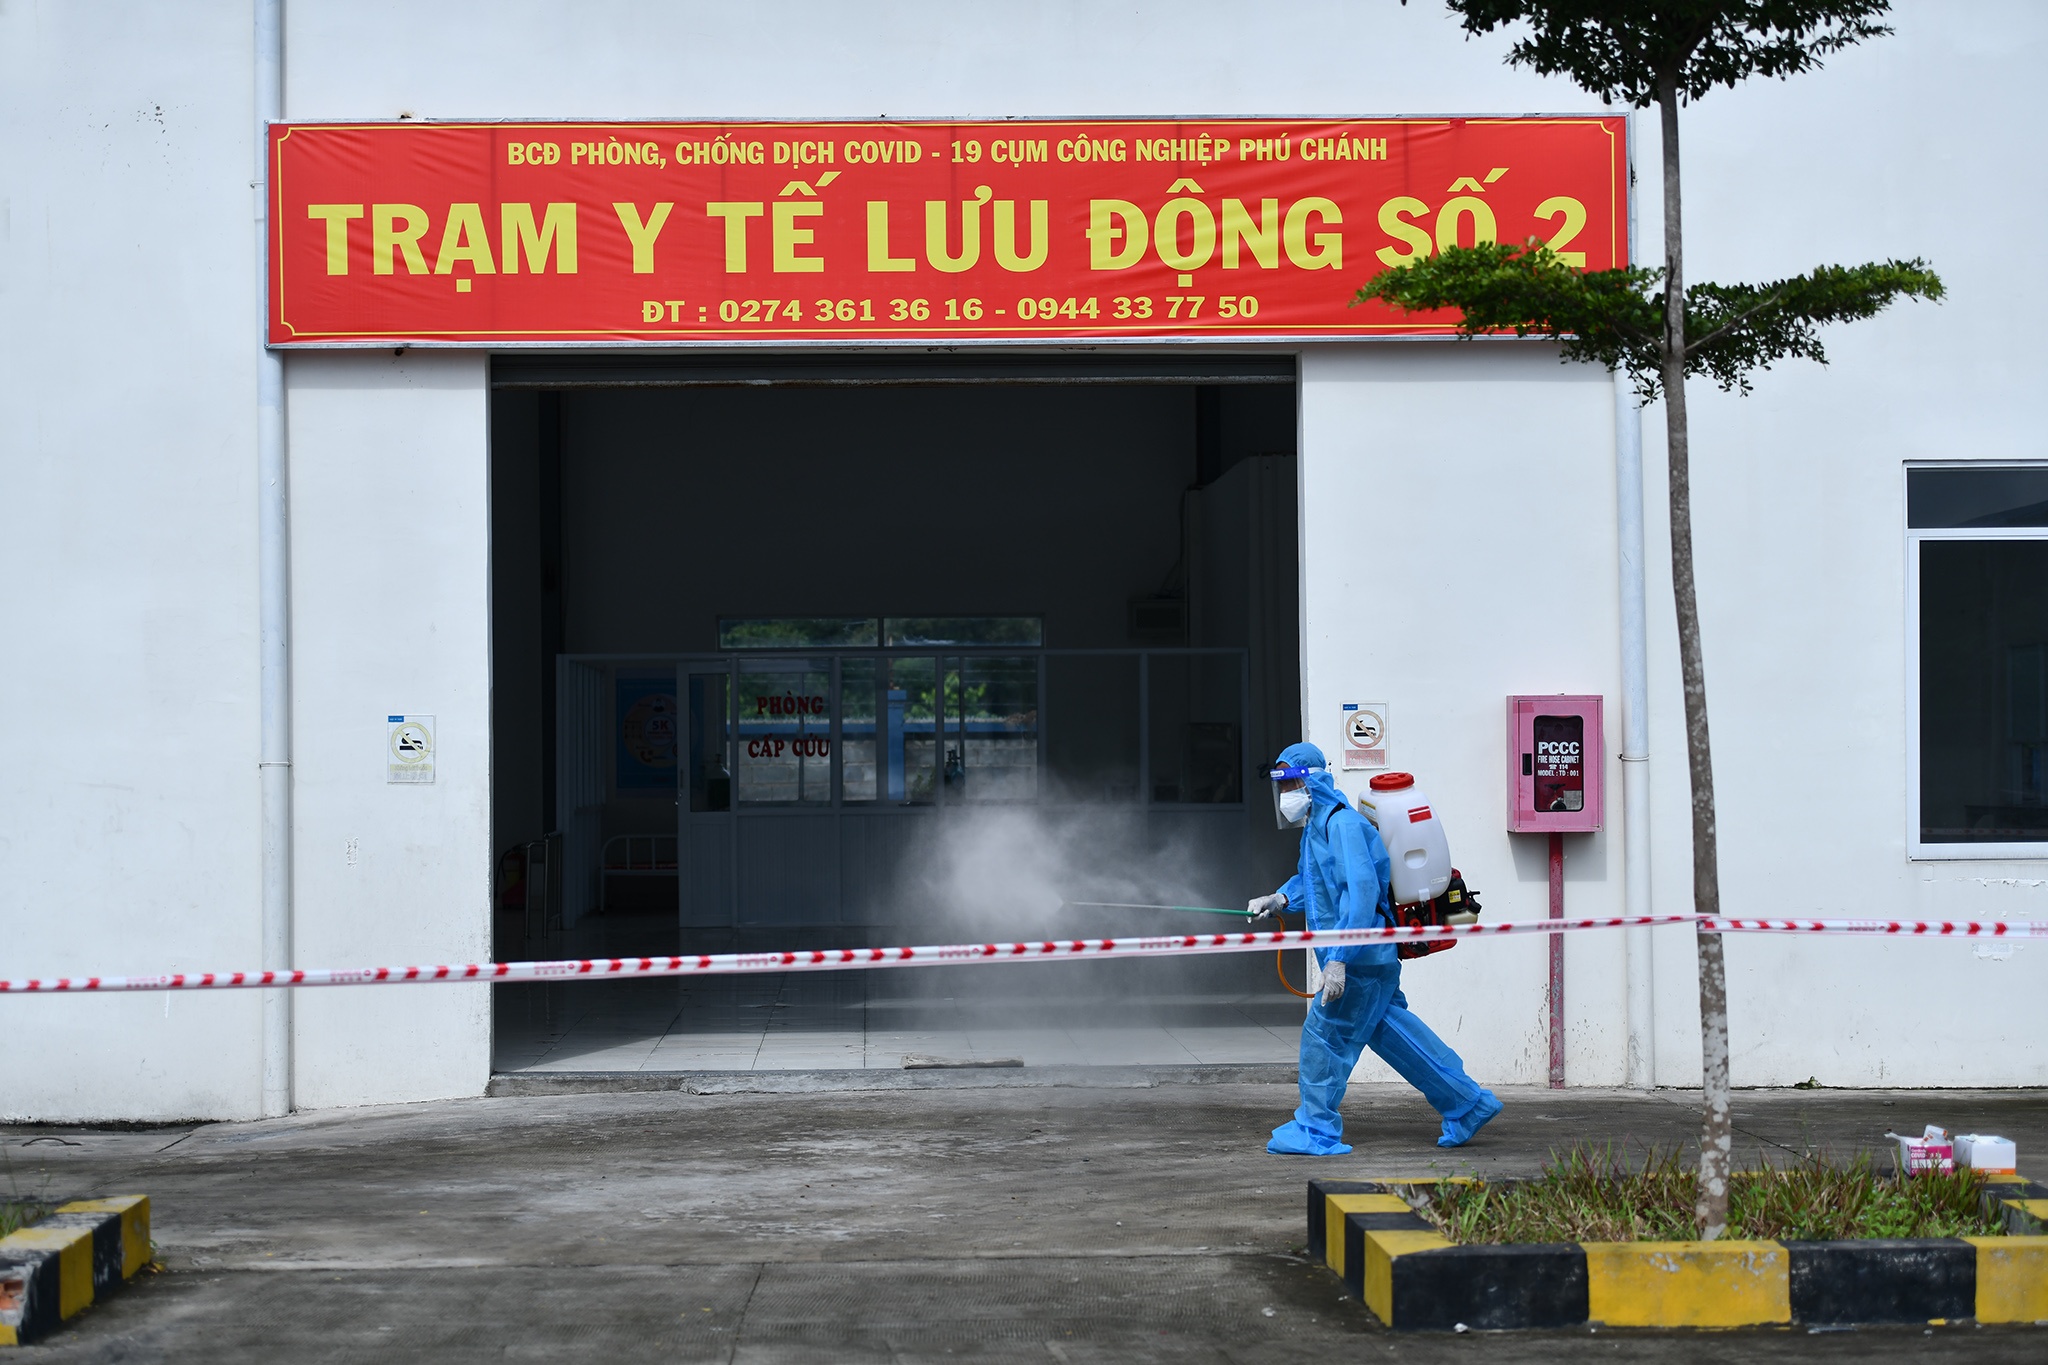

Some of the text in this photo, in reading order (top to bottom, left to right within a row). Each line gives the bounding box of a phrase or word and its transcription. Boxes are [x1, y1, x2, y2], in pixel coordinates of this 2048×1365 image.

[507, 141, 561, 166] BCĐ
[571, 136, 667, 170] PHÒNG,
[676, 132, 765, 165] CHỐNG
[773, 140, 835, 170] DỊCH
[843, 140, 922, 164] COVID
[951, 140, 982, 163] 19
[990, 139, 1048, 168] CỤM
[1056, 133, 1127, 163] CÔNG
[1135, 132, 1231, 167] NGHIỆP
[1239, 132, 1291, 161] PHÚ
[1300, 131, 1387, 161] CHÁNH
[307, 167, 1588, 293] TRẠM Y TẾ LƯU ĐỘNG SỐ 2
[641, 300, 685, 323] ĐT
[698, 306, 707, 323] :
[719, 299, 803, 323] 0274
[814, 299, 876, 322] 361
[888, 298, 931, 321] 36
[944, 298, 984, 321] 16
[1017, 297, 1101, 320] 0944
[1112, 296, 1153, 319] 33
[1165, 296, 1206, 319] 77
[1218, 295, 1259, 319] 50
[756, 690, 823, 715] PHÒNG
[747, 733, 785, 758] CẤP
[1538, 741, 1580, 755] PCCC
[1537, 755, 1548, 764] FIRE
[1548, 755, 1560, 764] HOSE
